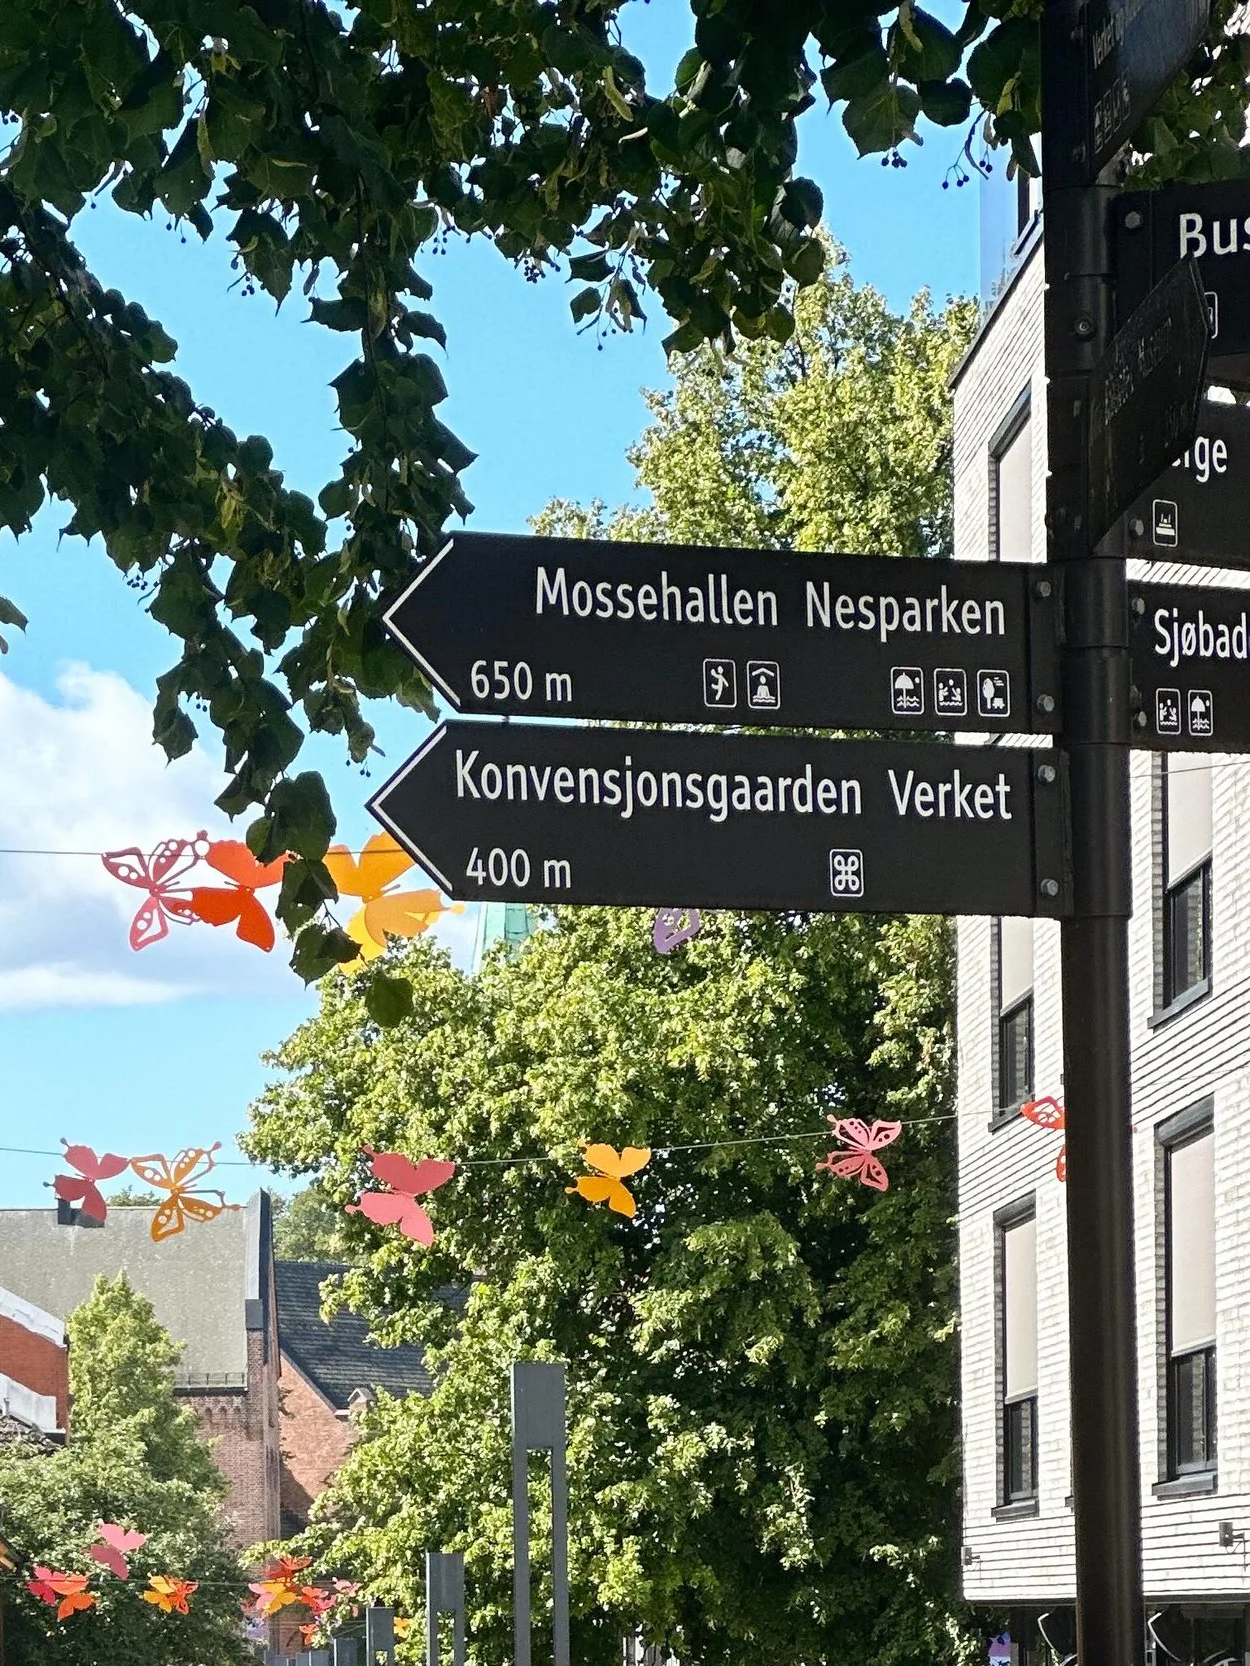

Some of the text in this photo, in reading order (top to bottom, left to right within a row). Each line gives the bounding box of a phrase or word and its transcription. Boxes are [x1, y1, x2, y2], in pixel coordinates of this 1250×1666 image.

[535, 566, 1005, 643] Mossehallen Nesparken
[1153, 607, 1249, 668] Sjøbad
[469, 659, 573, 702] 650 m
[454, 749, 1013, 823] Konvensjonsgaarden Verket
[464, 846, 572, 889] 400 m
